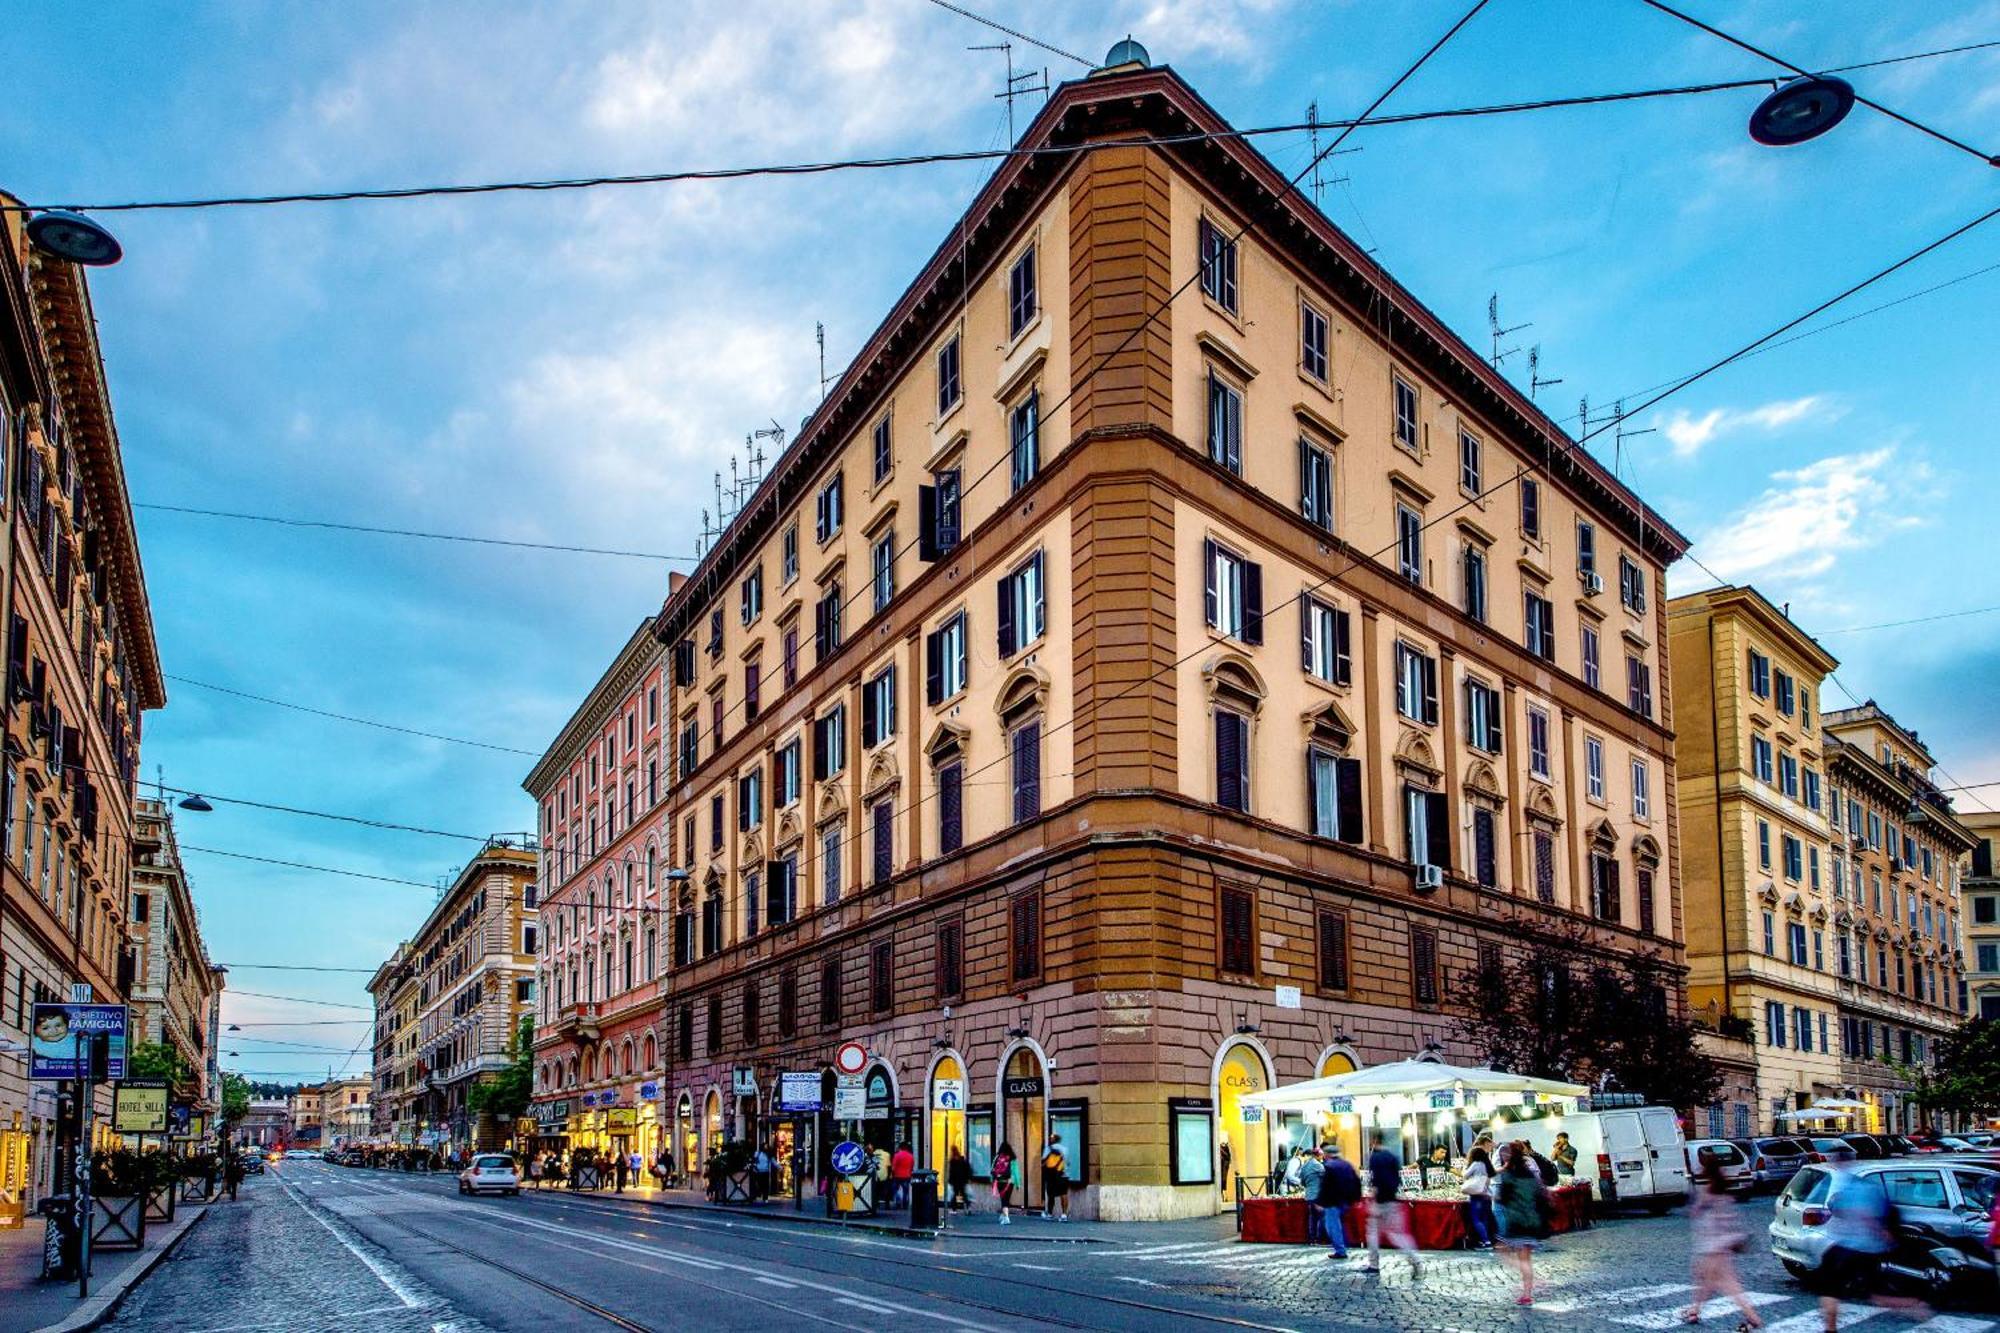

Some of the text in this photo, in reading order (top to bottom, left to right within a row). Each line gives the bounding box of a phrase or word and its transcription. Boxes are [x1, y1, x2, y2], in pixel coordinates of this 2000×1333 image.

[72, 1011, 123, 1020] OBIETTIVO
[69, 1020, 123, 1029] FAMIGLIA
[1226, 1076, 1258, 1087] CLASS
[1010, 1082, 1037, 1093] CLASS
[119, 1102, 165, 1112] HOTEL SILLA
